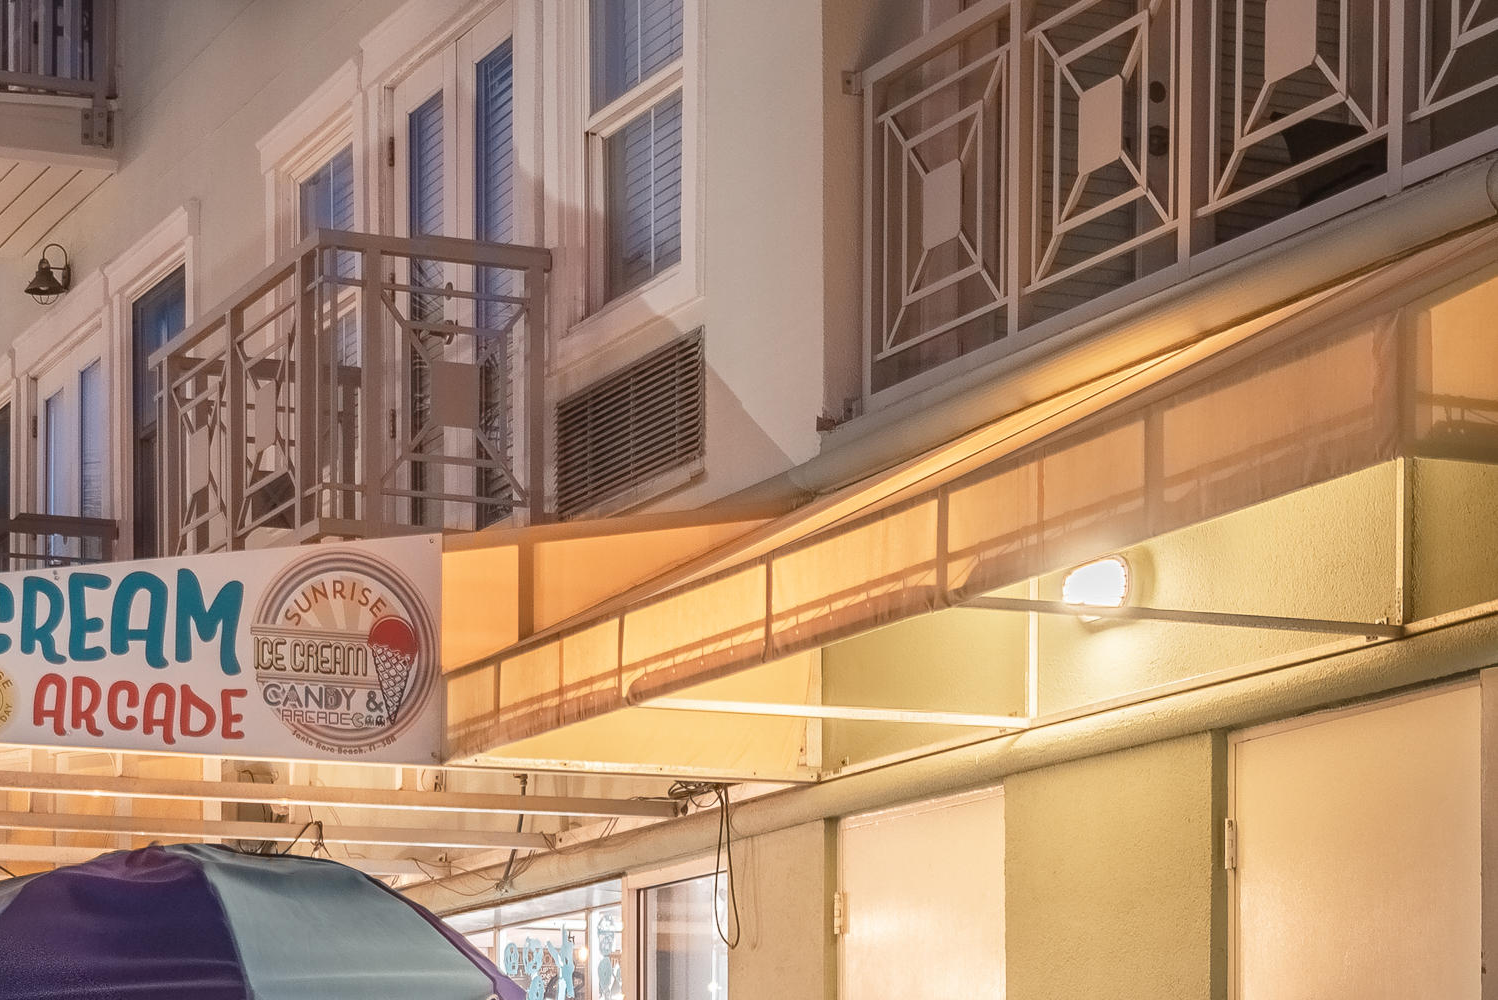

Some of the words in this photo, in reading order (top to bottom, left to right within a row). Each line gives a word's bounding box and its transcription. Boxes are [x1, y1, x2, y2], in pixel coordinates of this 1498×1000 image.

[284, 579, 388, 626] SUNRISE
[253, 636, 287, 672] ICE
[290, 639, 368, 677] CREAM
[0, 703, 13, 723] DAY
[33, 672, 249, 745] ARCADE
[262, 682, 356, 711] CANDY
[366, 690, 384, 713] &
[281, 708, 352, 725] ARCADE
